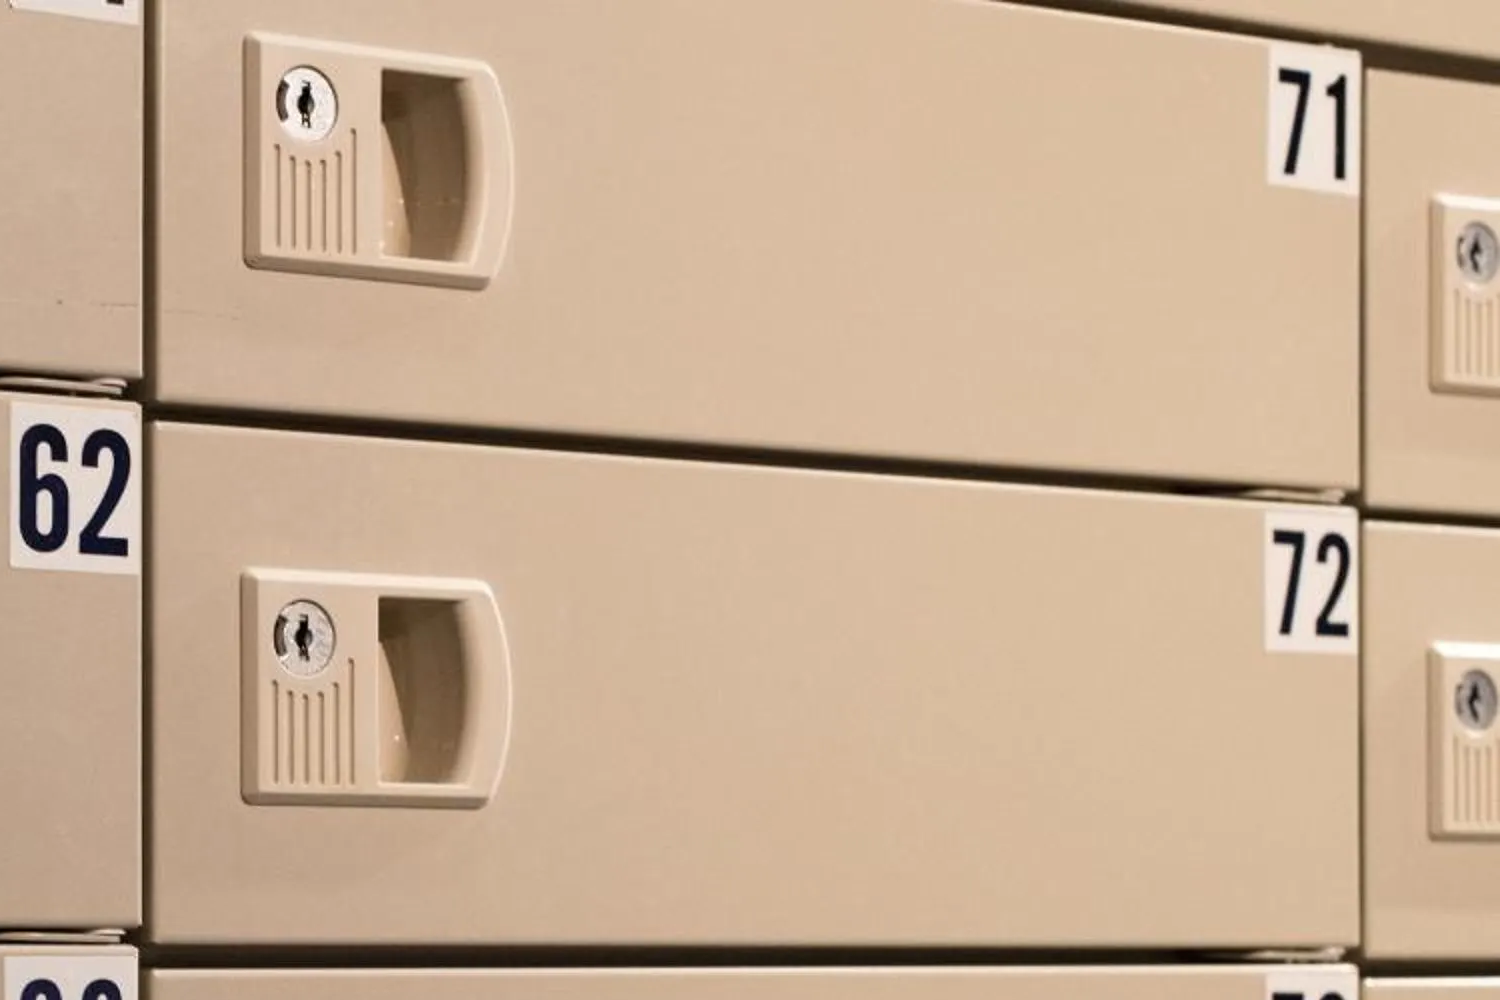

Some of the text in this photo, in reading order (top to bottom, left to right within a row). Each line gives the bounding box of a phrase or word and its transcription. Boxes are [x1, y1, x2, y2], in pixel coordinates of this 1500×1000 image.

[1278, 68, 1347, 180] 71
[19, 423, 131, 557] 62
[1273, 529, 1350, 637] 72
